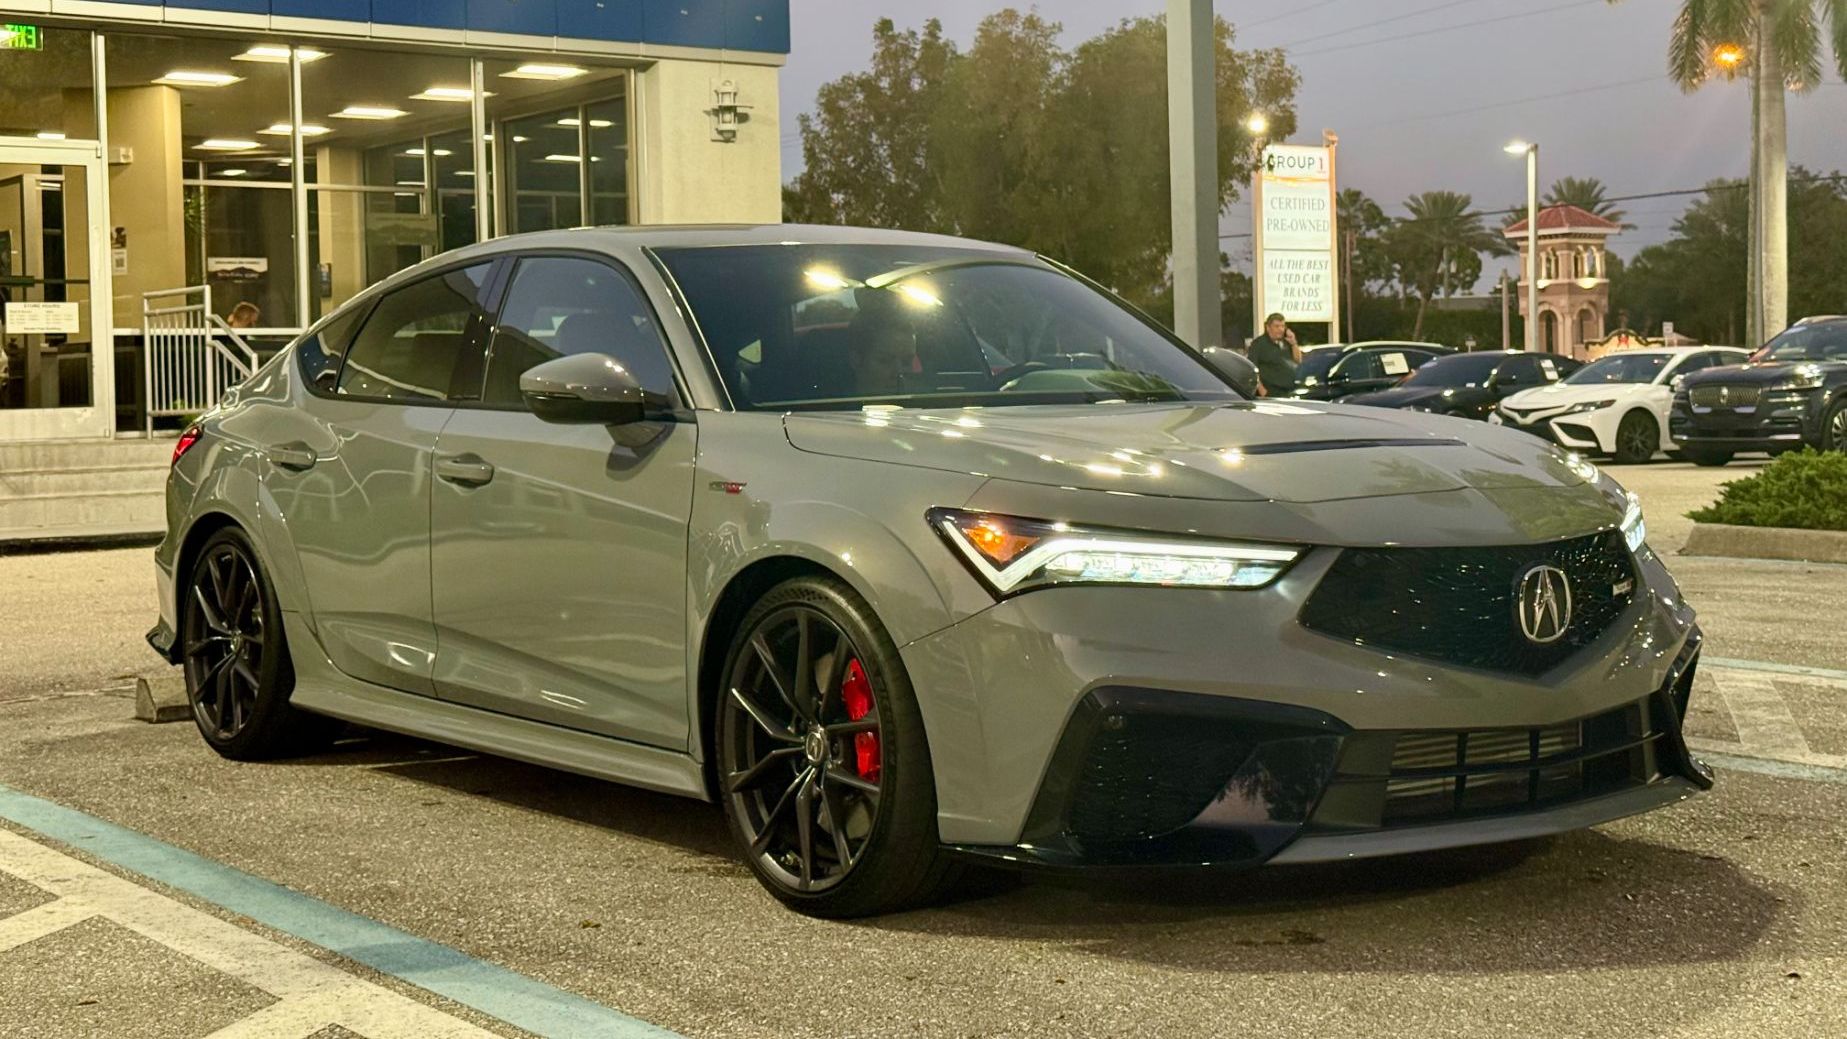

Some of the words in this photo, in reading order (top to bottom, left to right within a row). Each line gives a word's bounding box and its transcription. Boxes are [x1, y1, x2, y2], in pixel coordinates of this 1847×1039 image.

[1270, 196, 1325, 211] CERTIFIED
[1266, 217, 1330, 232] PRE-OWNED
[1270, 258, 1285, 270] ALL
[1287, 259, 1304, 270] THE
[1306, 260, 1329, 270] BEST
[1277, 273, 1301, 284] USED
[1302, 273, 1321, 284] CAR
[1283, 287, 1320, 298] BRANDS
[1281, 300, 1299, 311] FOR
[1301, 300, 1323, 311] LESS
